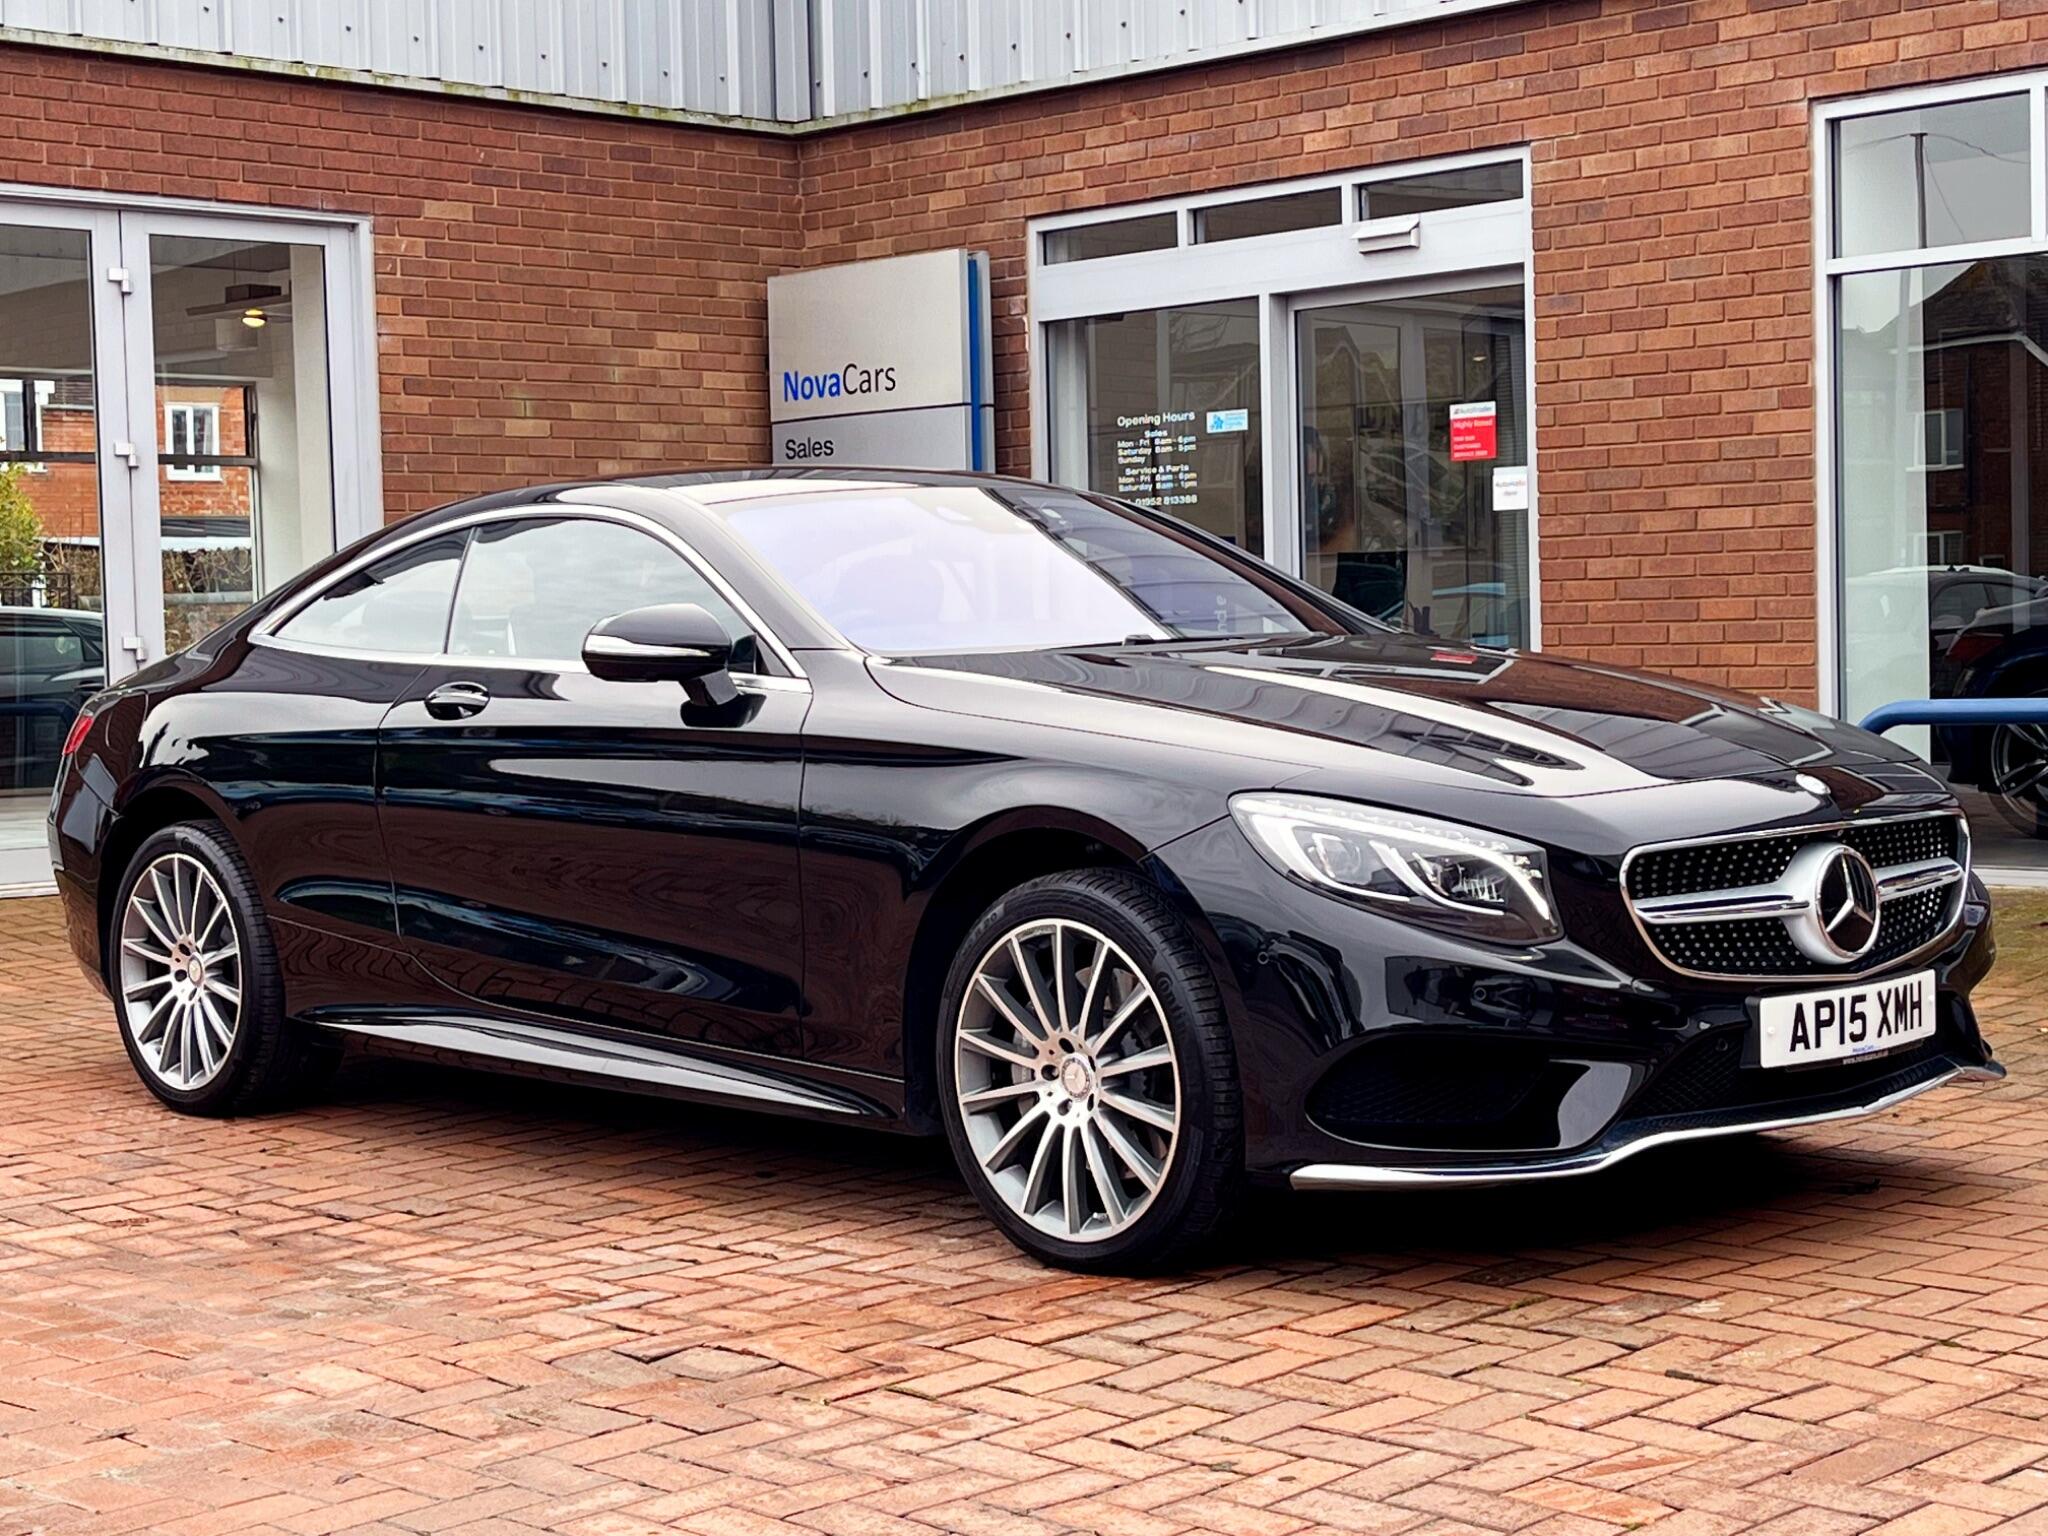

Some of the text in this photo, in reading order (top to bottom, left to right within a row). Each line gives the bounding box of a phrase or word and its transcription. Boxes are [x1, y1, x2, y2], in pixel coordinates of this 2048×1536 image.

[783, 363, 897, 402] NovaCars
[1117, 412, 1195, 427] Opening Hours
[1144, 429, 1168, 438] Sales
[1117, 440, 1134, 448] Mon
[1139, 438, 1150, 447] Fri
[785, 437, 834, 460] Sales
[1118, 447, 1152, 455] Saturday
[1118, 456, 1145, 464] Sunday
[1126, 467, 1157, 475] Service
[1166, 464, 1189, 472] Parts
[1118, 475, 1135, 484] Mon
[1139, 474, 1151, 483] Fri
[1118, 483, 1153, 492] Saturday
[1789, 980, 1922, 1053] AP15 XMH
